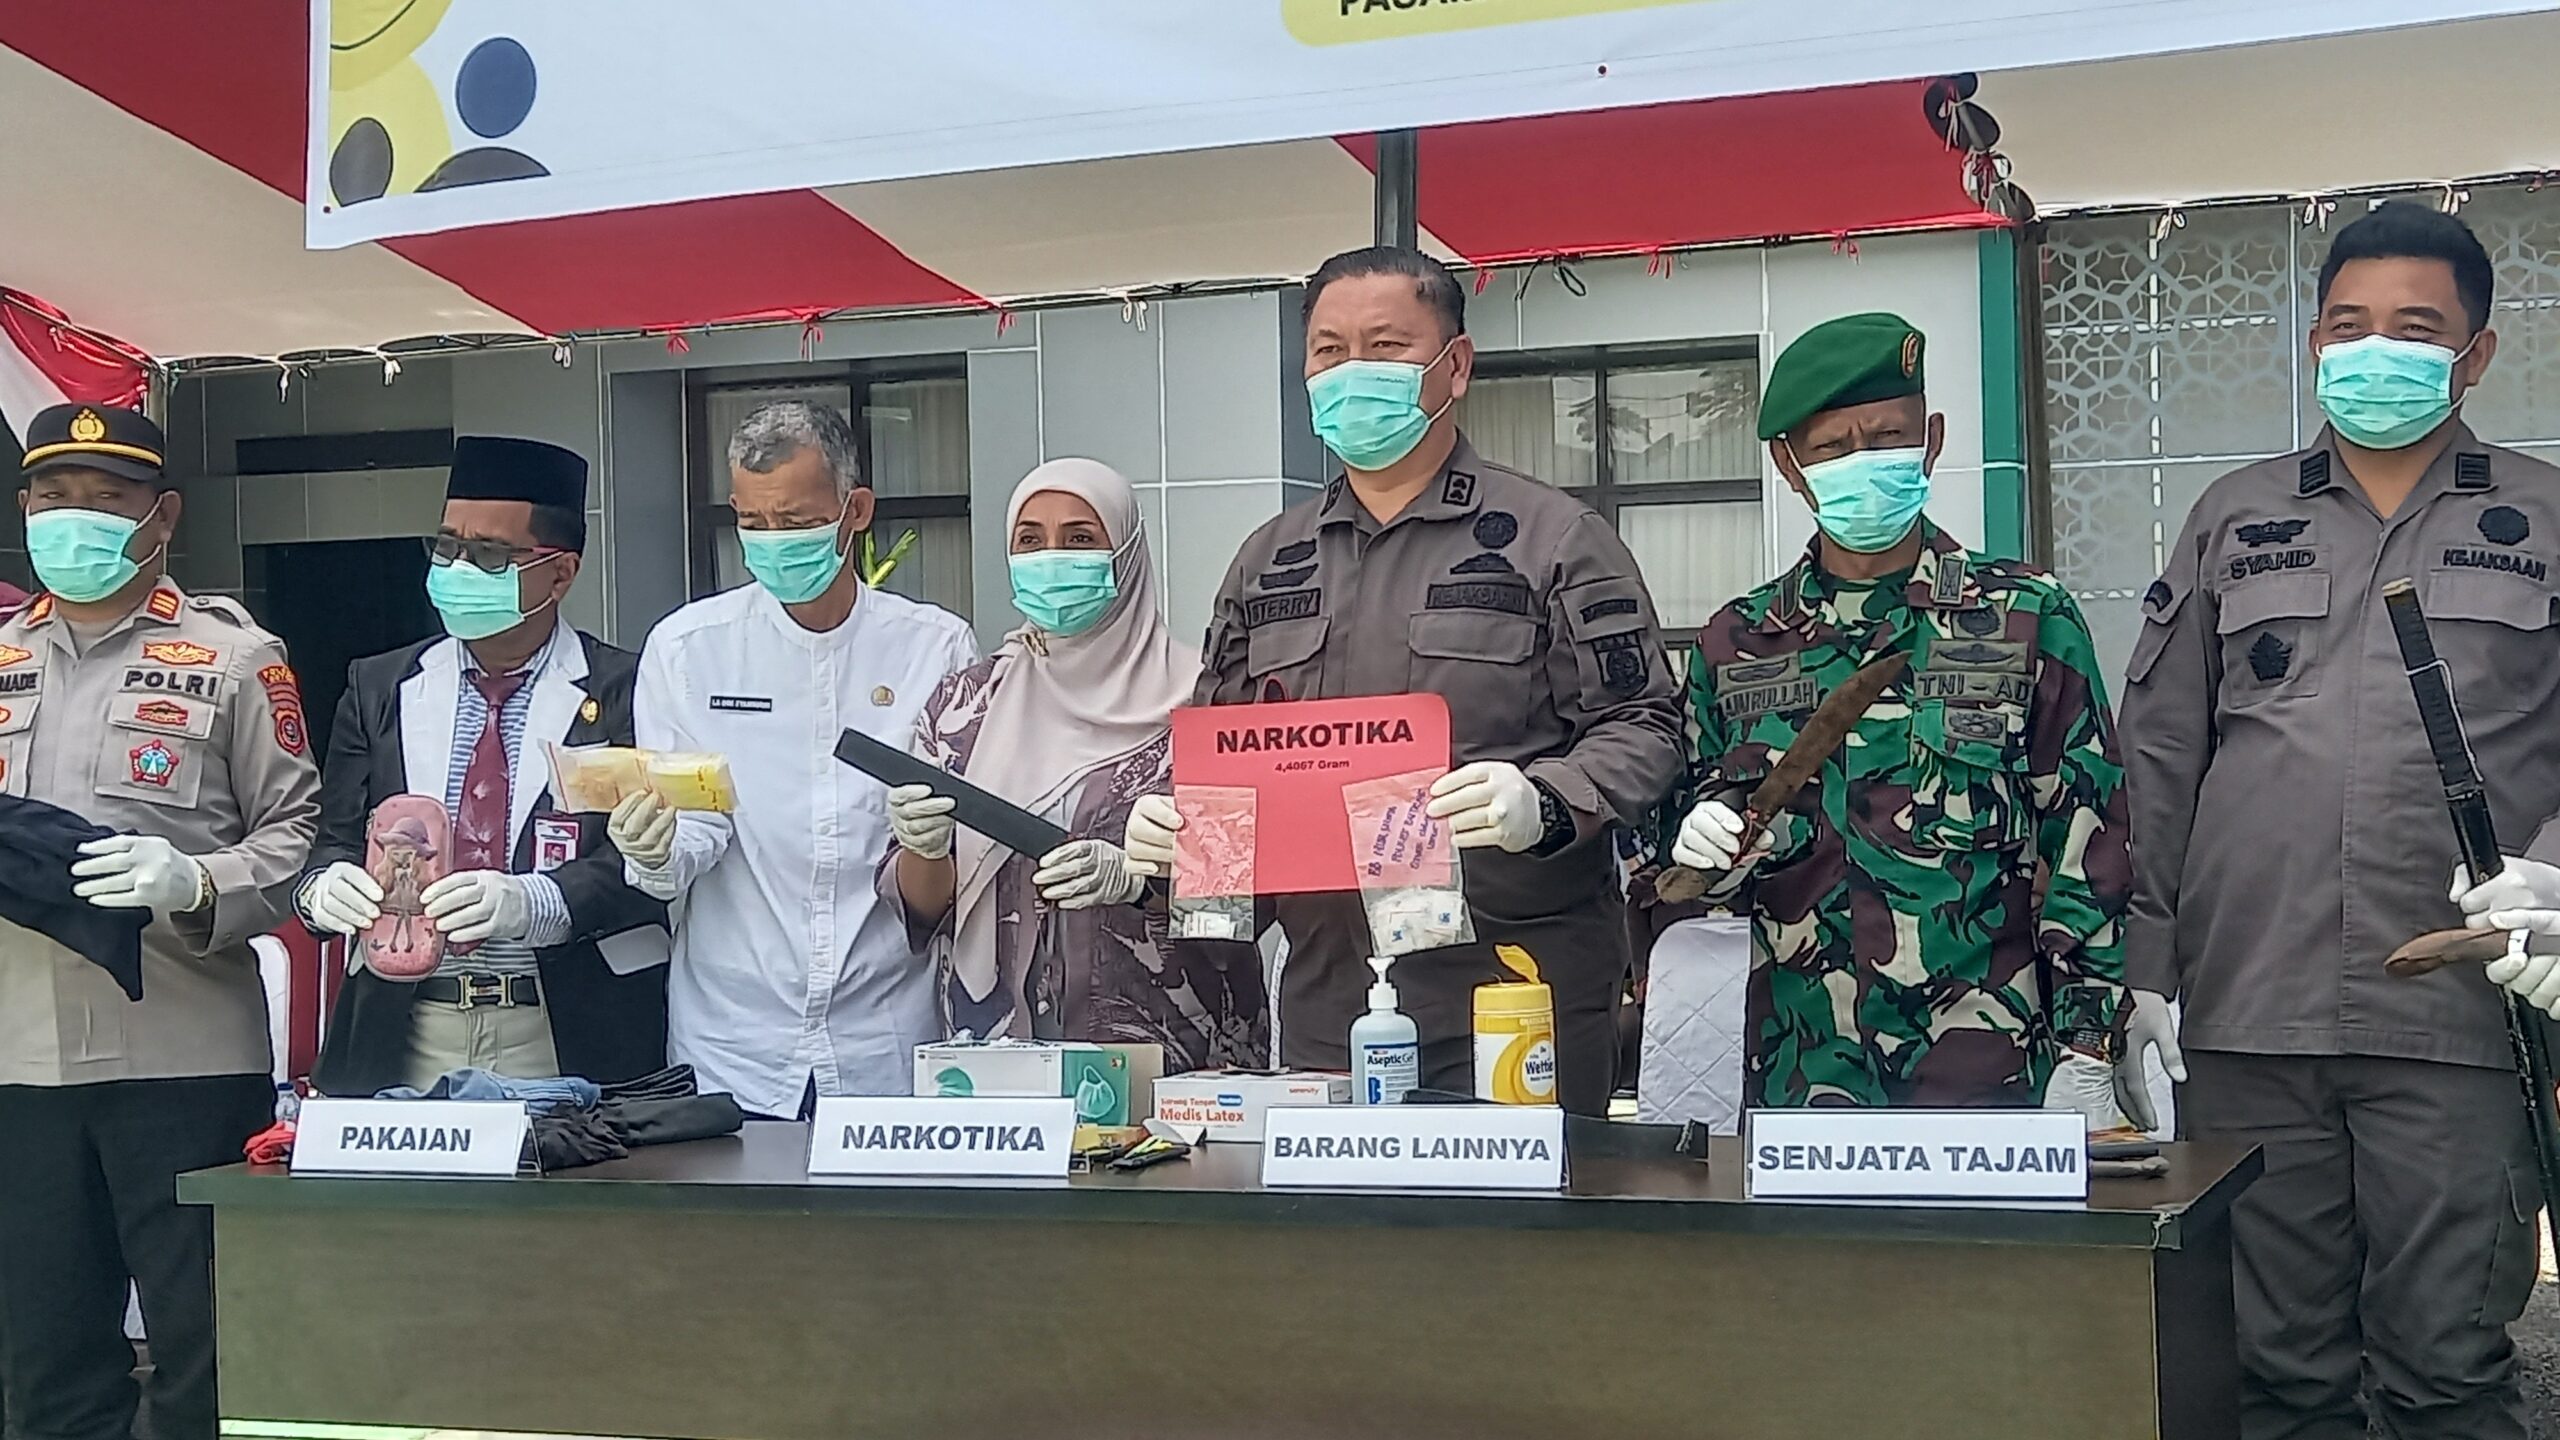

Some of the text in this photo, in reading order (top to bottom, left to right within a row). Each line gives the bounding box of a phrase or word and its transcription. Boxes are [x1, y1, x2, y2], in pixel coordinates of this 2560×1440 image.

[2231, 549, 2316, 580] SYAHID
[124, 670, 218, 697] POLRI
[1919, 675, 1965, 696] TNI
[1217, 719, 1414, 754] NARKOTIKA
[1318, 759, 1350, 770] Gram
[1367, 1054, 1401, 1068] Aseptic
[1160, 1108, 1245, 1122] Medis Latex
[340, 1126, 471, 1152] PAKAIAN
[842, 1125, 1045, 1151] NARKOTIKA
[1274, 1136, 1551, 1161] BARANG LAINNYA
[1758, 1145, 2077, 1173] SENJATA TAJAM
